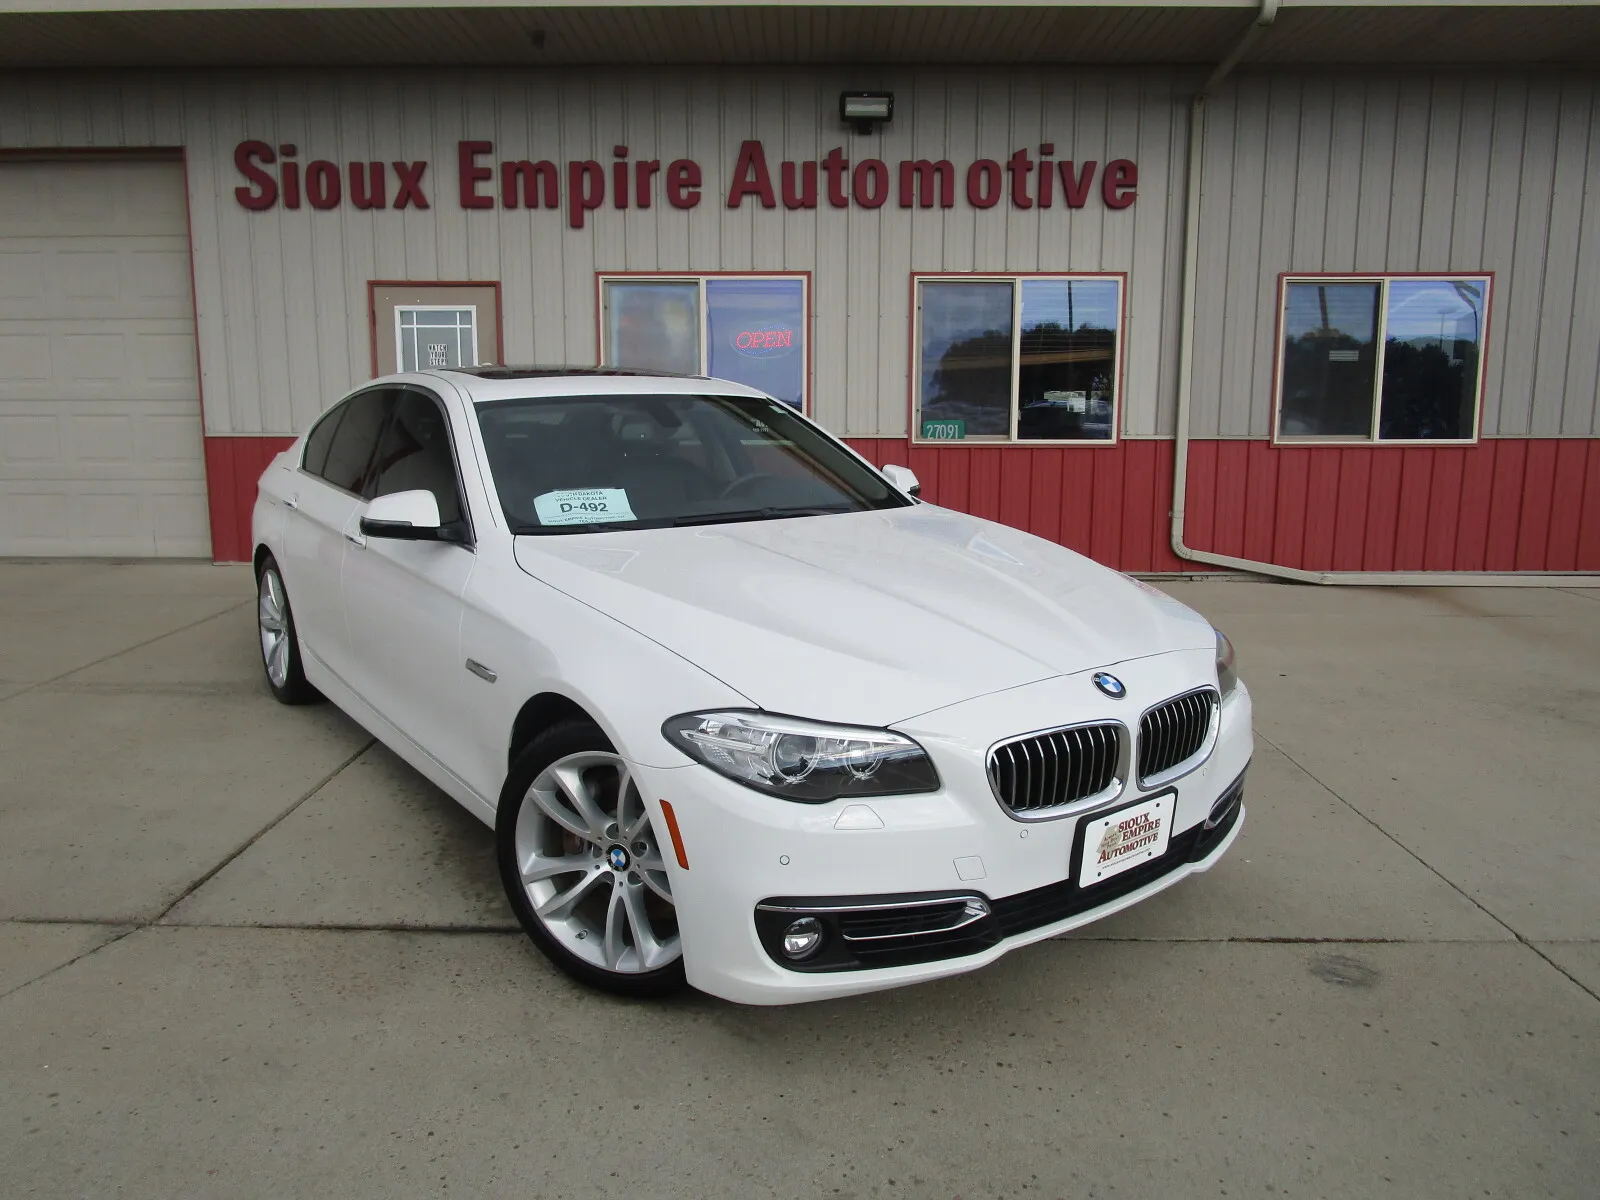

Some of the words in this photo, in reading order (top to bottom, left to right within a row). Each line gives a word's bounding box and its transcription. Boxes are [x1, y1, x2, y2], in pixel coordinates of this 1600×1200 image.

[233, 139, 431, 211] Sioux
[458, 139, 703, 229] Empire
[727, 139, 1138, 210] Automotive
[735, 329, 792, 349] OPEN
[926, 424, 959, 439] 27091
[559, 502, 609, 513] D-492
[1118, 812, 1150, 833] SIOUX
[1122, 818, 1161, 842] EMPIRE
[1097, 832, 1159, 864] AUTOMOTIVE
